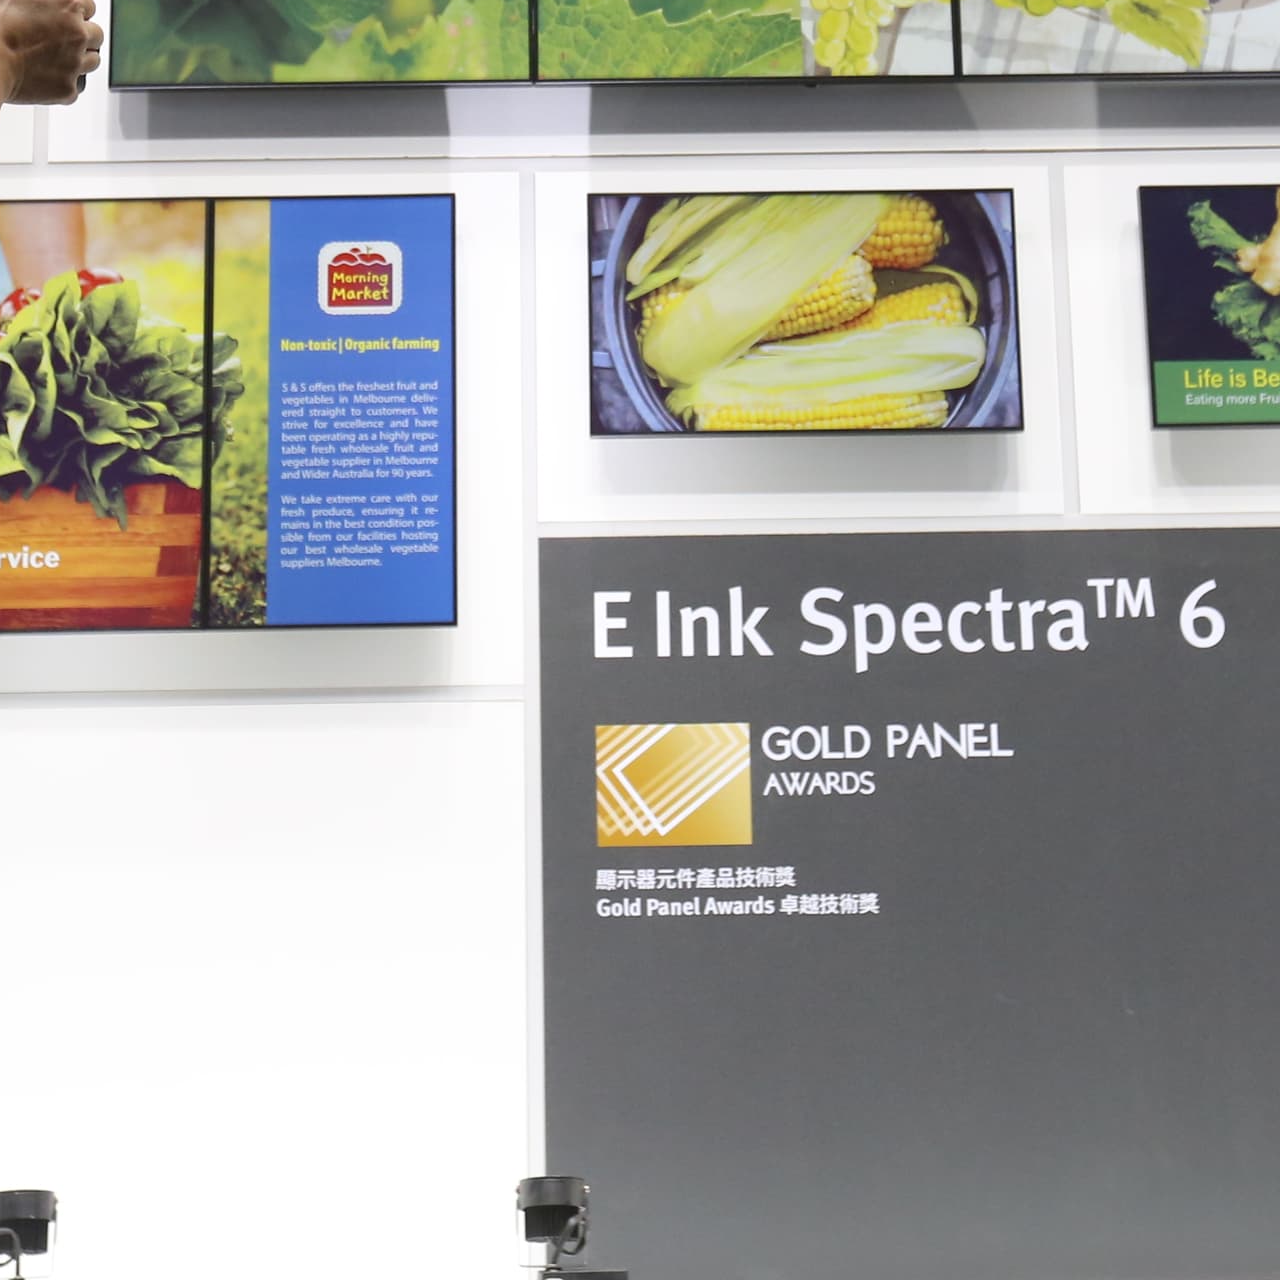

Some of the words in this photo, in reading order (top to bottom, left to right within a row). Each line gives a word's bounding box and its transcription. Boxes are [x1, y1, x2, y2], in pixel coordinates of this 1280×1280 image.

[333, 272, 388, 286] Morning
[332, 287, 388, 301] Market
[281, 339, 336, 351] Non-toxic
[345, 338, 390, 353] Organic
[392, 337, 439, 352] farming
[1184, 370, 1223, 388] Life
[1230, 369, 1246, 387] is
[594, 591, 632, 658] E
[656, 586, 774, 657] Ink
[1180, 580, 1226, 648] 6
[761, 726, 871, 761] GOLD
[887, 723, 1013, 758] PANEL
[764, 772, 875, 795] AWARDS
[597, 897, 642, 917] Gold
[646, 897, 701, 917] Panel
[705, 895, 775, 915] Awards
